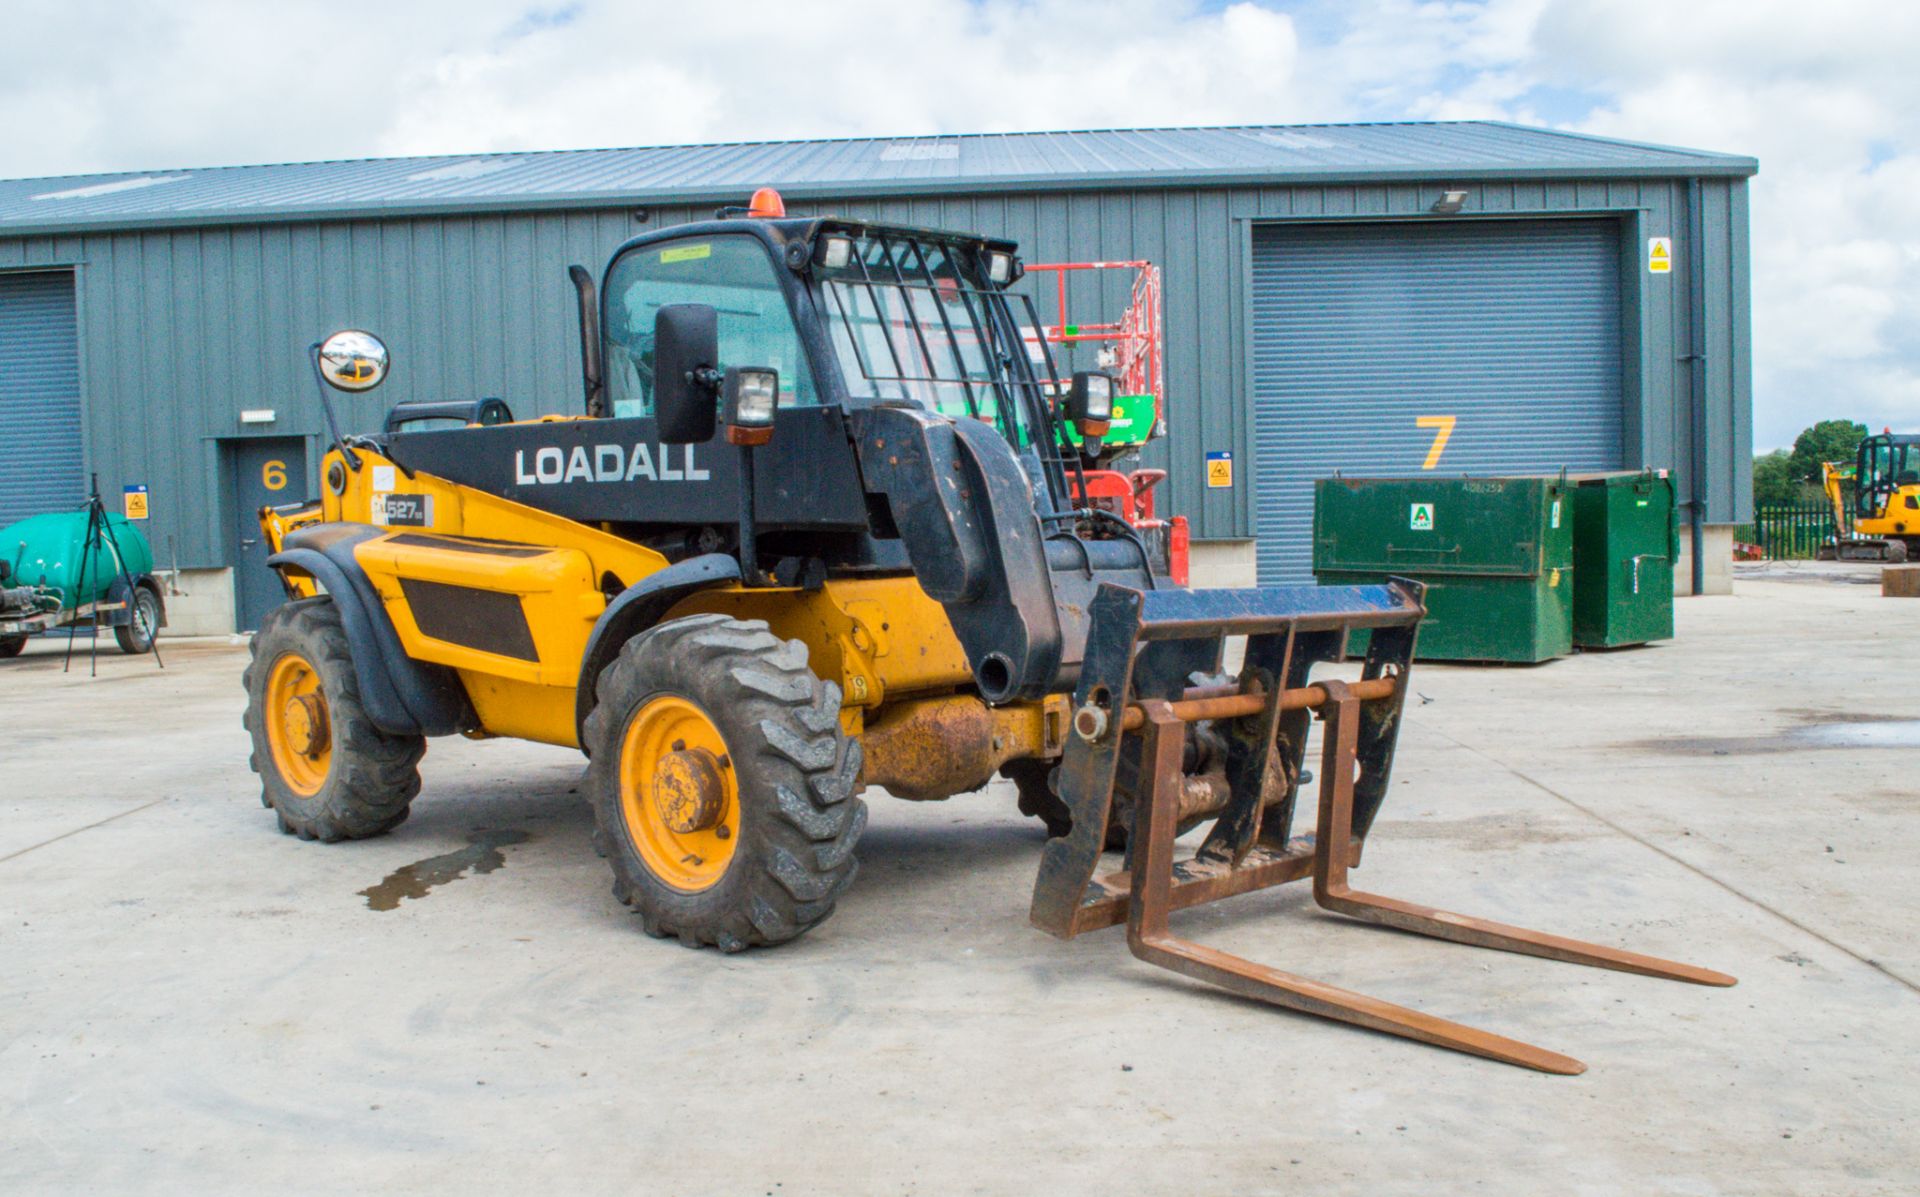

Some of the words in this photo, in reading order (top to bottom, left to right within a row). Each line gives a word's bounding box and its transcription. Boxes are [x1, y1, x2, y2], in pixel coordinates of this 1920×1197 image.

[1416, 415, 1456, 470] 7
[262, 460, 288, 491] 6
[516, 442, 710, 485] LOADALL
[387, 501, 417, 519] 527
[1414, 506, 1431, 521] A
